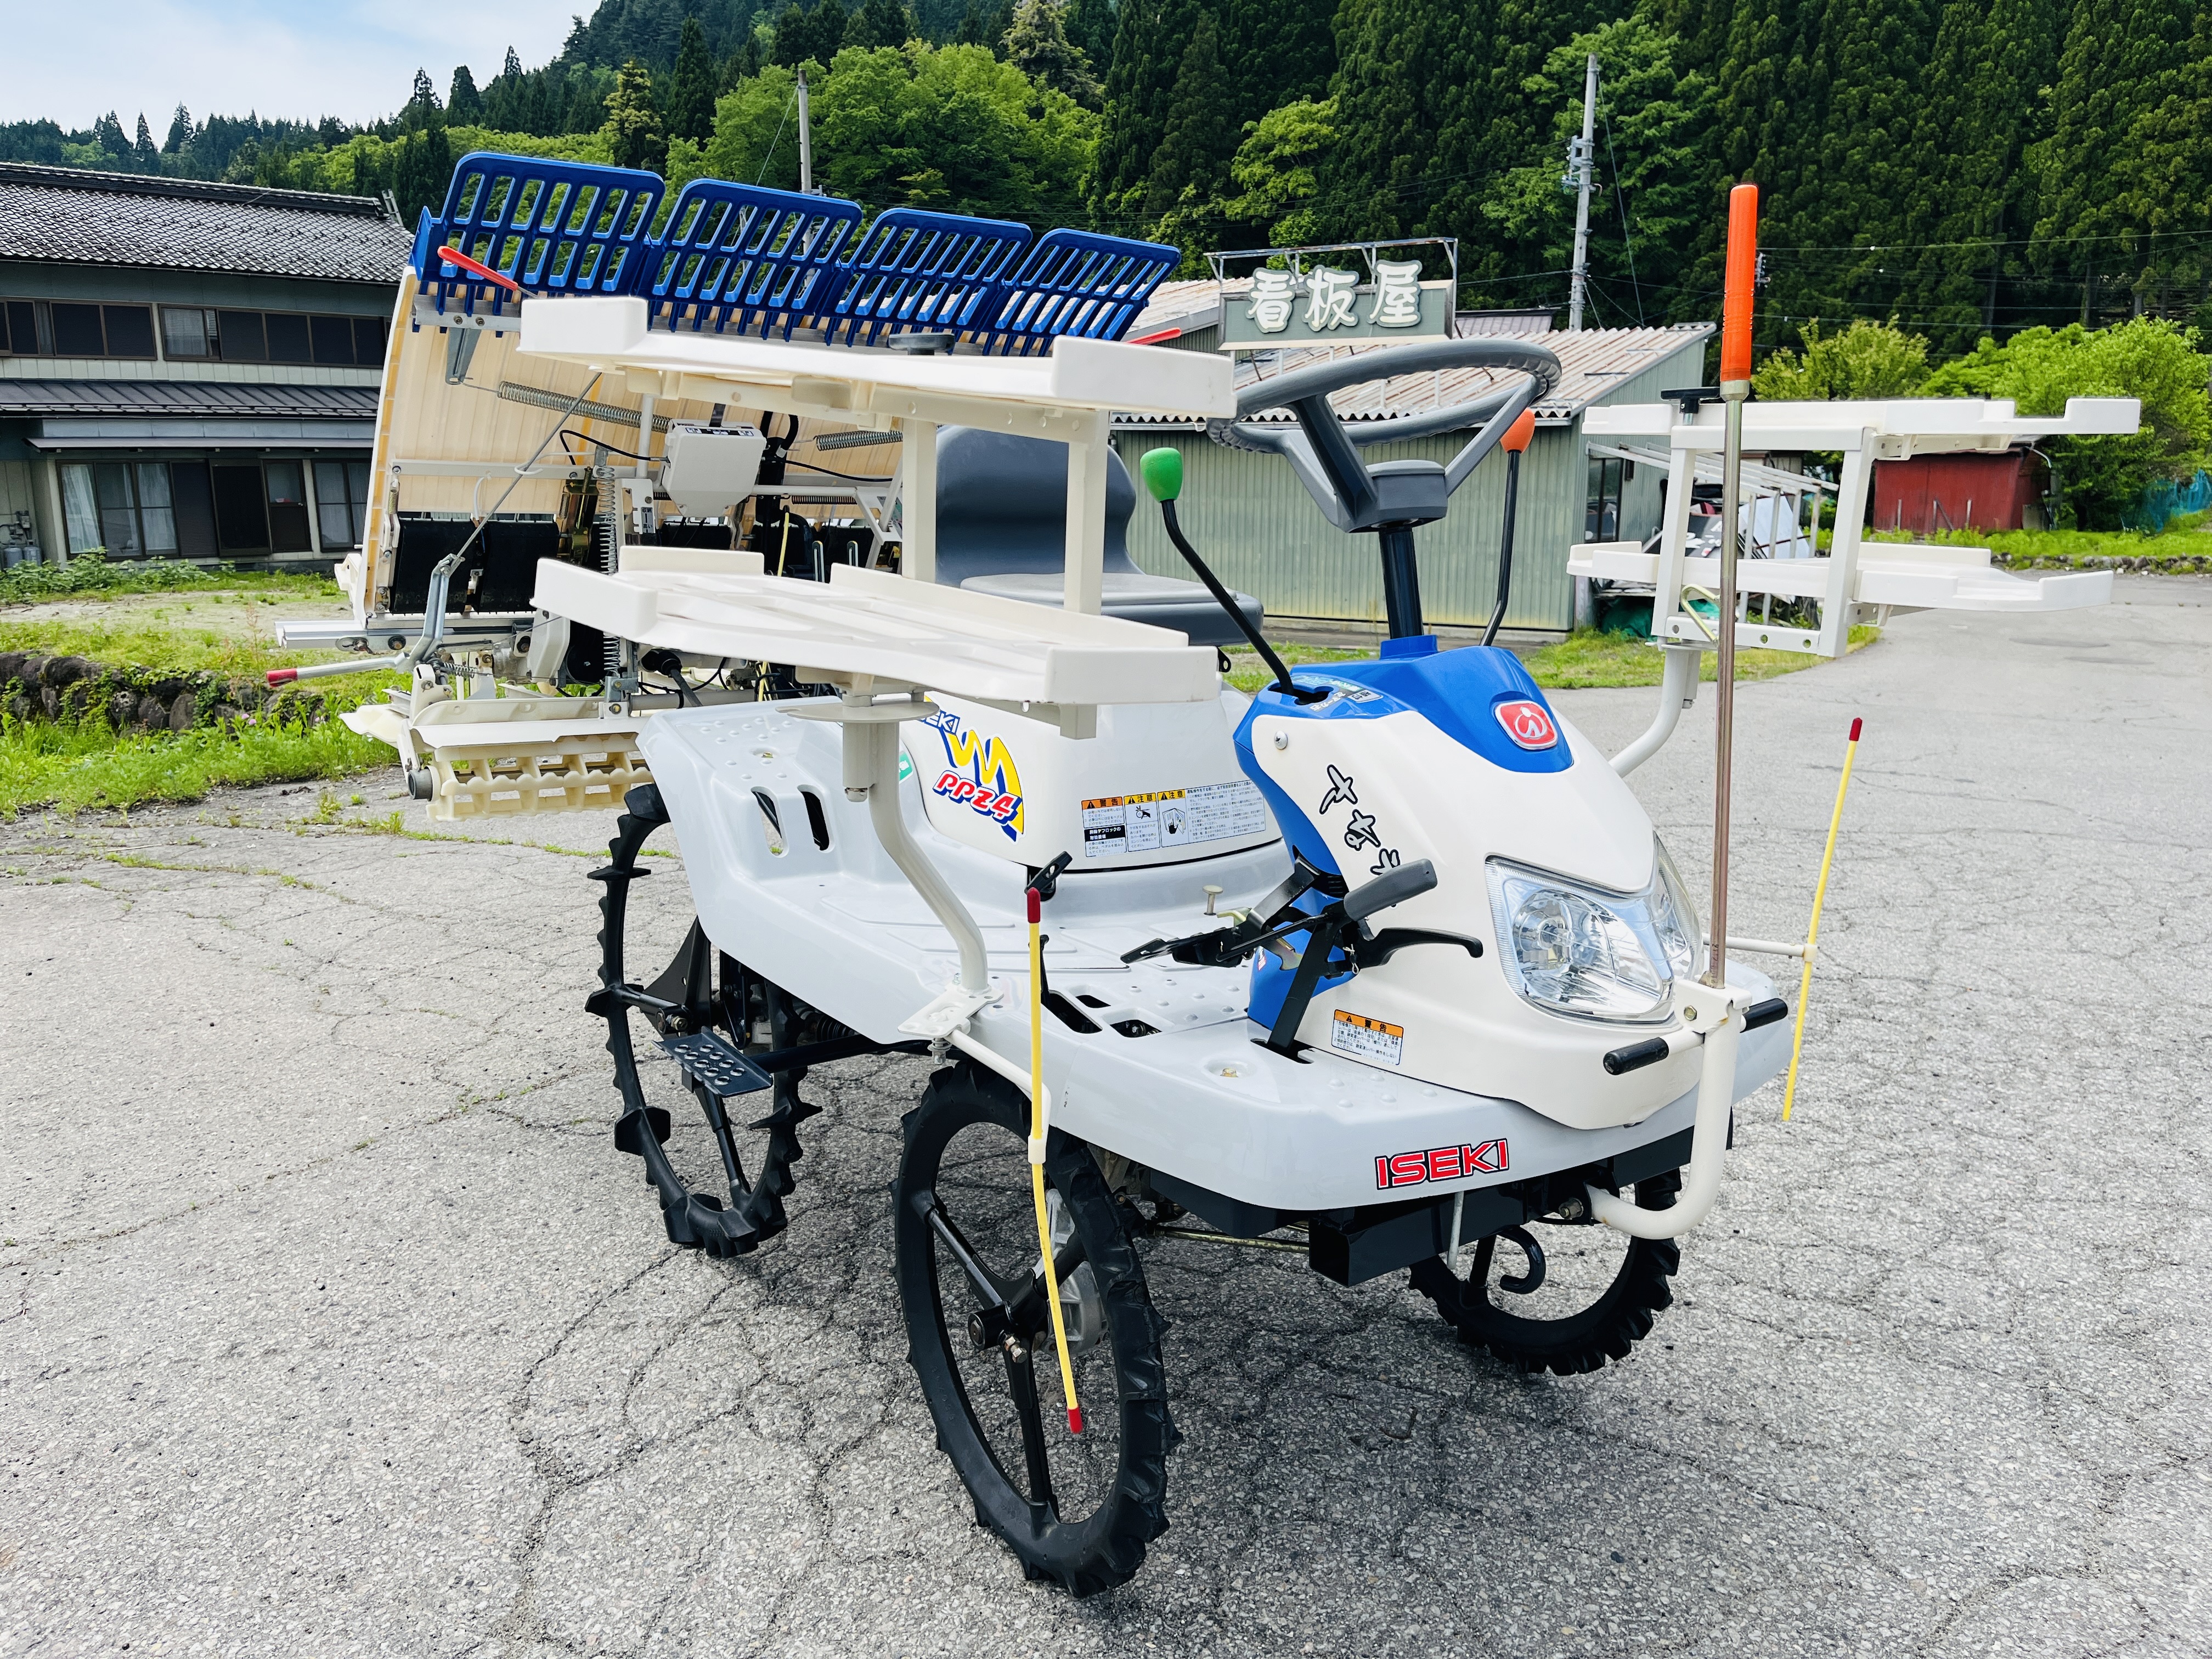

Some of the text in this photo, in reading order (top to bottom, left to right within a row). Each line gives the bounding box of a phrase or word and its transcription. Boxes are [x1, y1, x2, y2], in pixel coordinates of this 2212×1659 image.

[1248, 262, 1420, 330] 看板屋
[921, 713, 960, 733] EKI
[934, 771, 1017, 822] PPZ4
[1099, 798, 1119, 807] 警告
[1137, 794, 1153, 803] 注意
[1169, 791, 1183, 799] 注意
[1364, 1019, 1387, 1033] 警告
[1375, 1138, 1509, 1189] ISEKI
